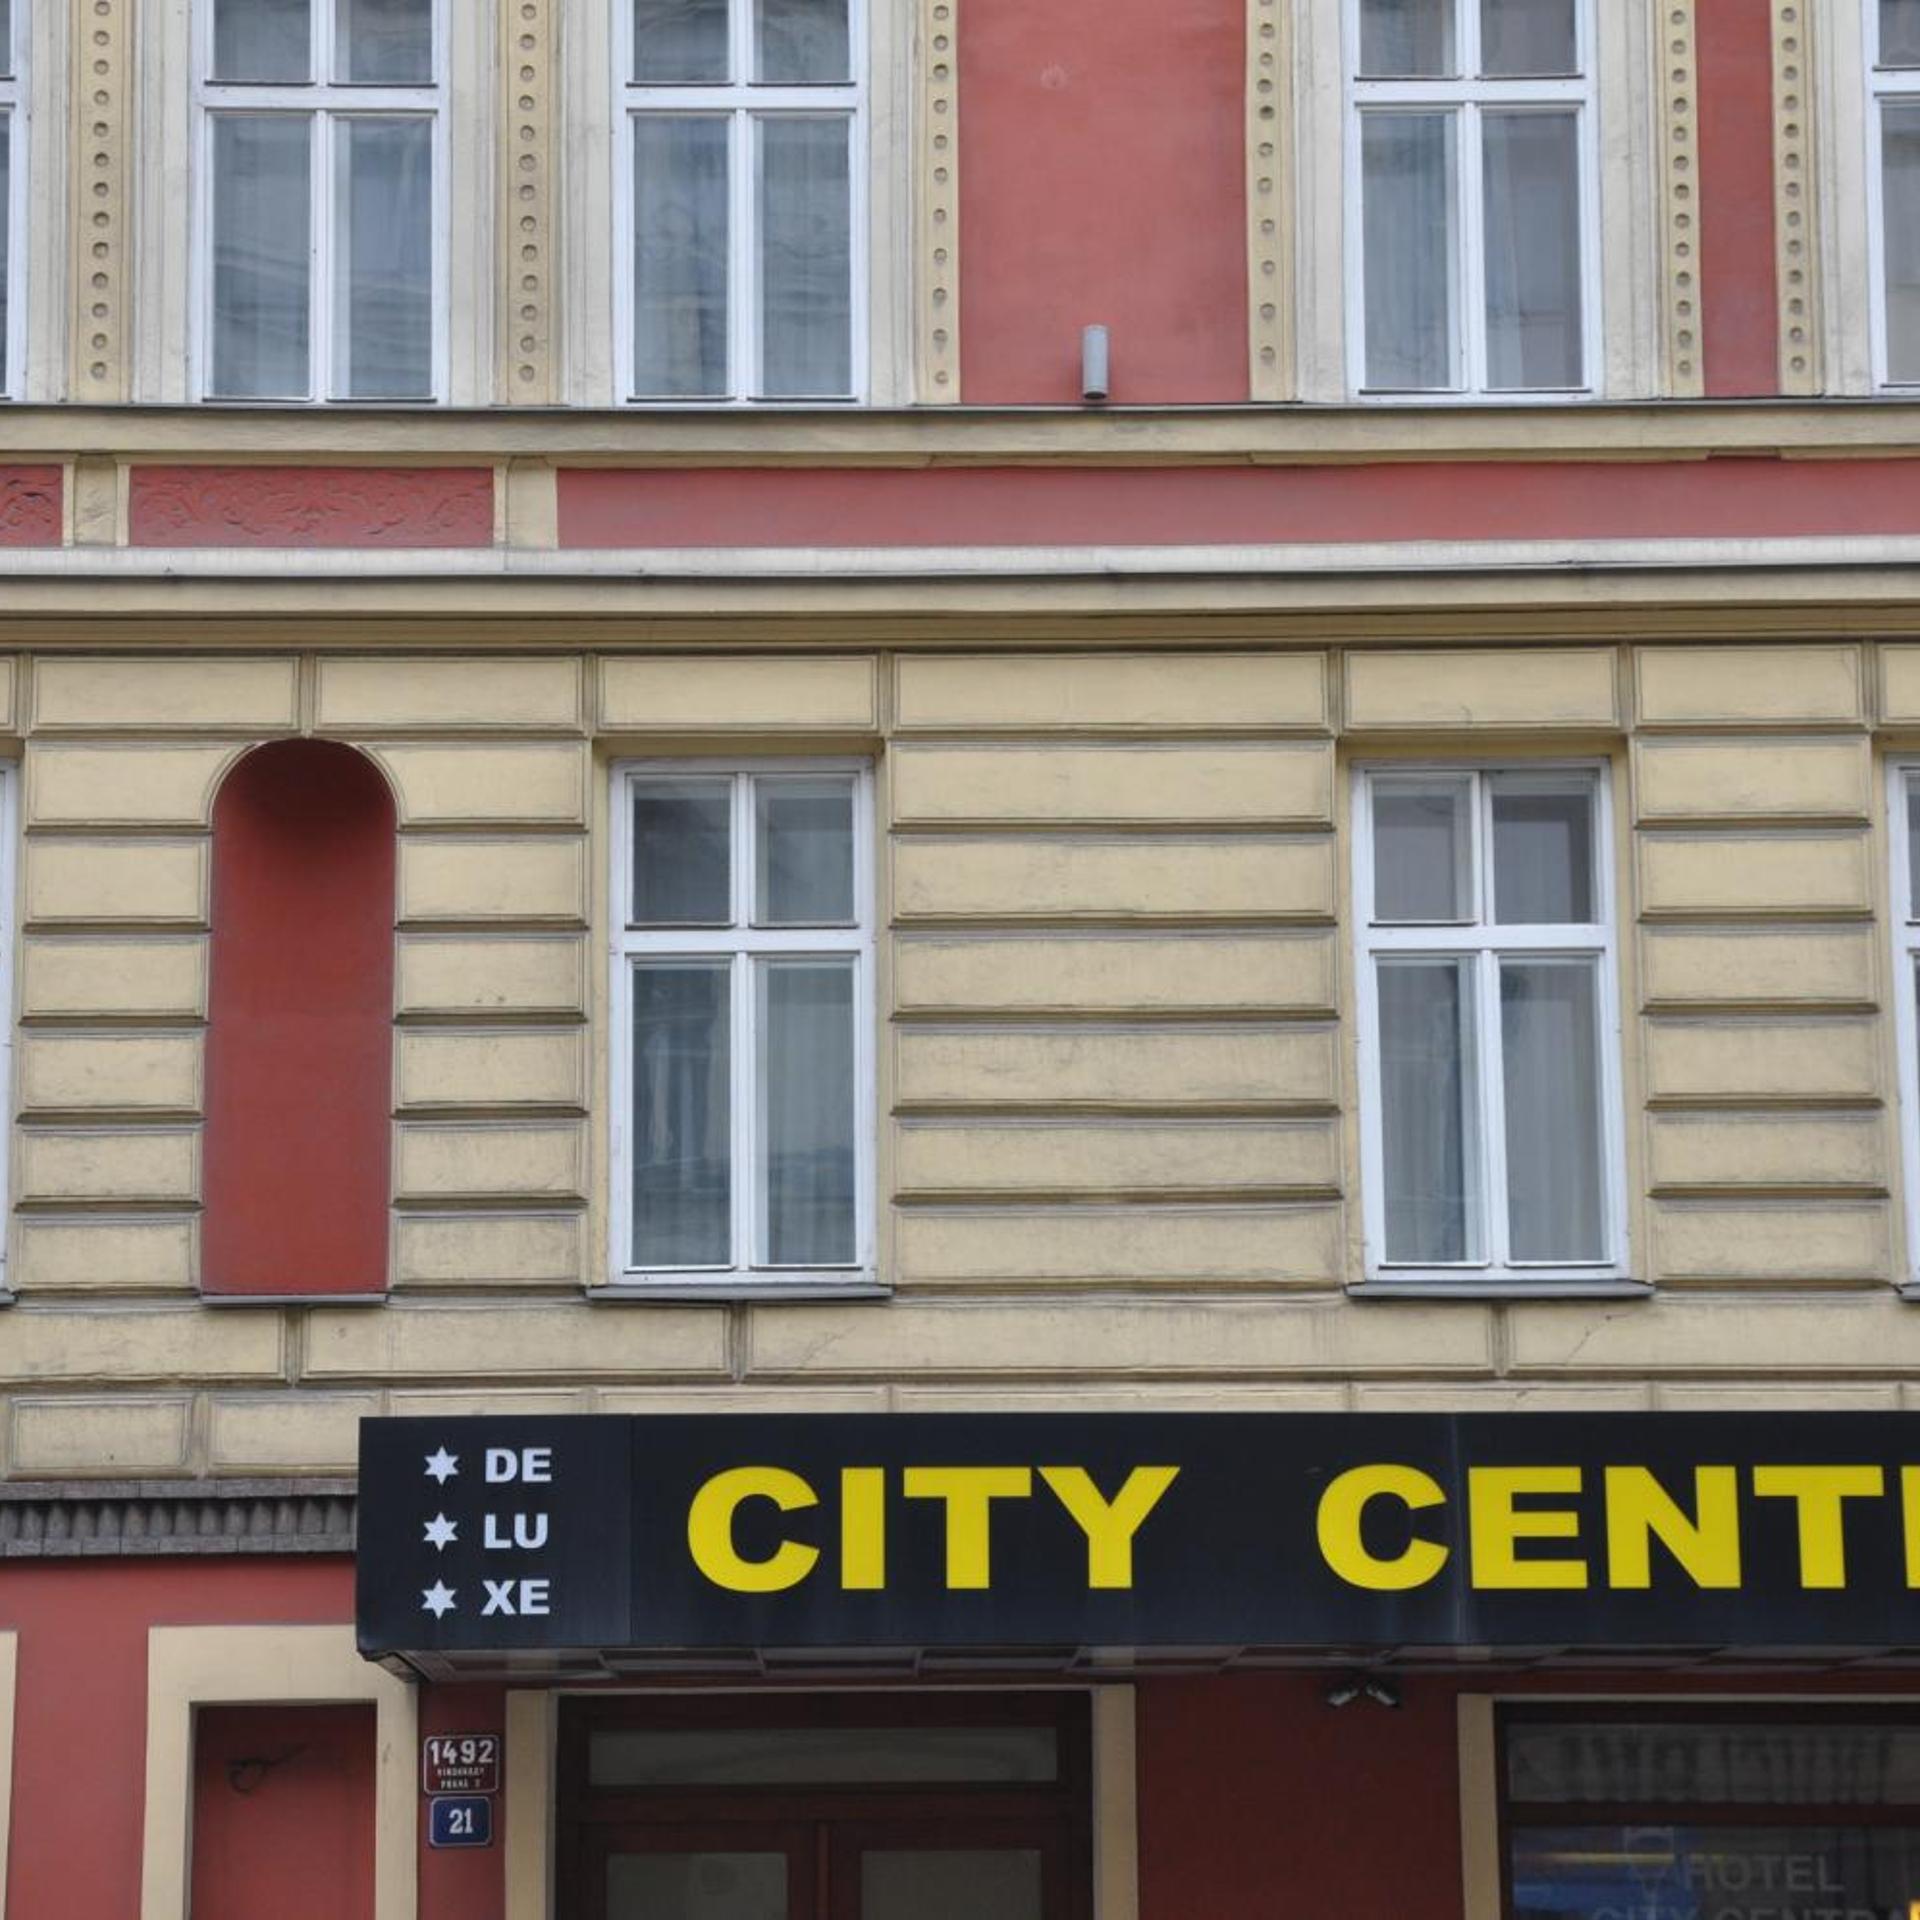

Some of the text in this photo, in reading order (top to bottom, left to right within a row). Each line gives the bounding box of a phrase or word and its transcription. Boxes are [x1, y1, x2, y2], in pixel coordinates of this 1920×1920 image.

[486, 1448, 552, 1483] DE
[484, 1513, 548, 1549] LU
[688, 1464, 1920, 1592] CITY CENT
[481, 1579, 550, 1615] XE
[430, 1740, 494, 1765] 1492
[448, 1808, 473, 1834] 21
[1683, 1854, 1845, 1892] HOTEL
